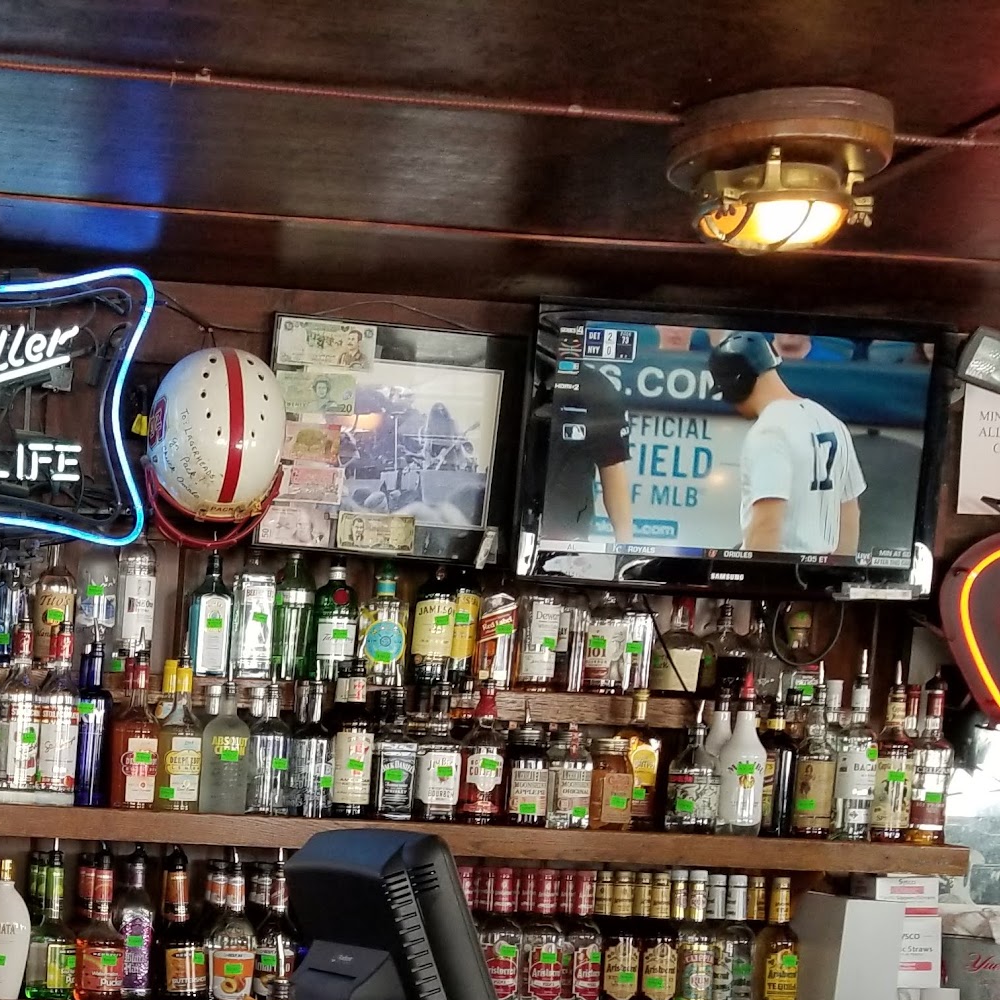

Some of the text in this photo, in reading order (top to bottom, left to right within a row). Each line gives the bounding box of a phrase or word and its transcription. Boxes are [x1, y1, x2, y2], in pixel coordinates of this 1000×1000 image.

[608, 333, 612, 342] 2
[607, 346, 611, 355] 0
[341, 403, 352, 413] 20
[629, 415, 711, 440] FFICIAL
[630, 443, 713, 479] IELD
[810, 431, 838, 492] 17
[652, 485, 698, 507] MLB
[628, 546, 656, 554] ROYALS
[724, 551, 752, 559] ORIOLES
[801, 555, 828, 564] 7:05 ET
[711, 573, 744, 581] SAMSUNG
[40, 595, 71, 606] Tito's
[483, 621, 496, 631] Red
[428, 790, 455, 798] BOURBON
[489, 966, 516, 975] ristocrat
